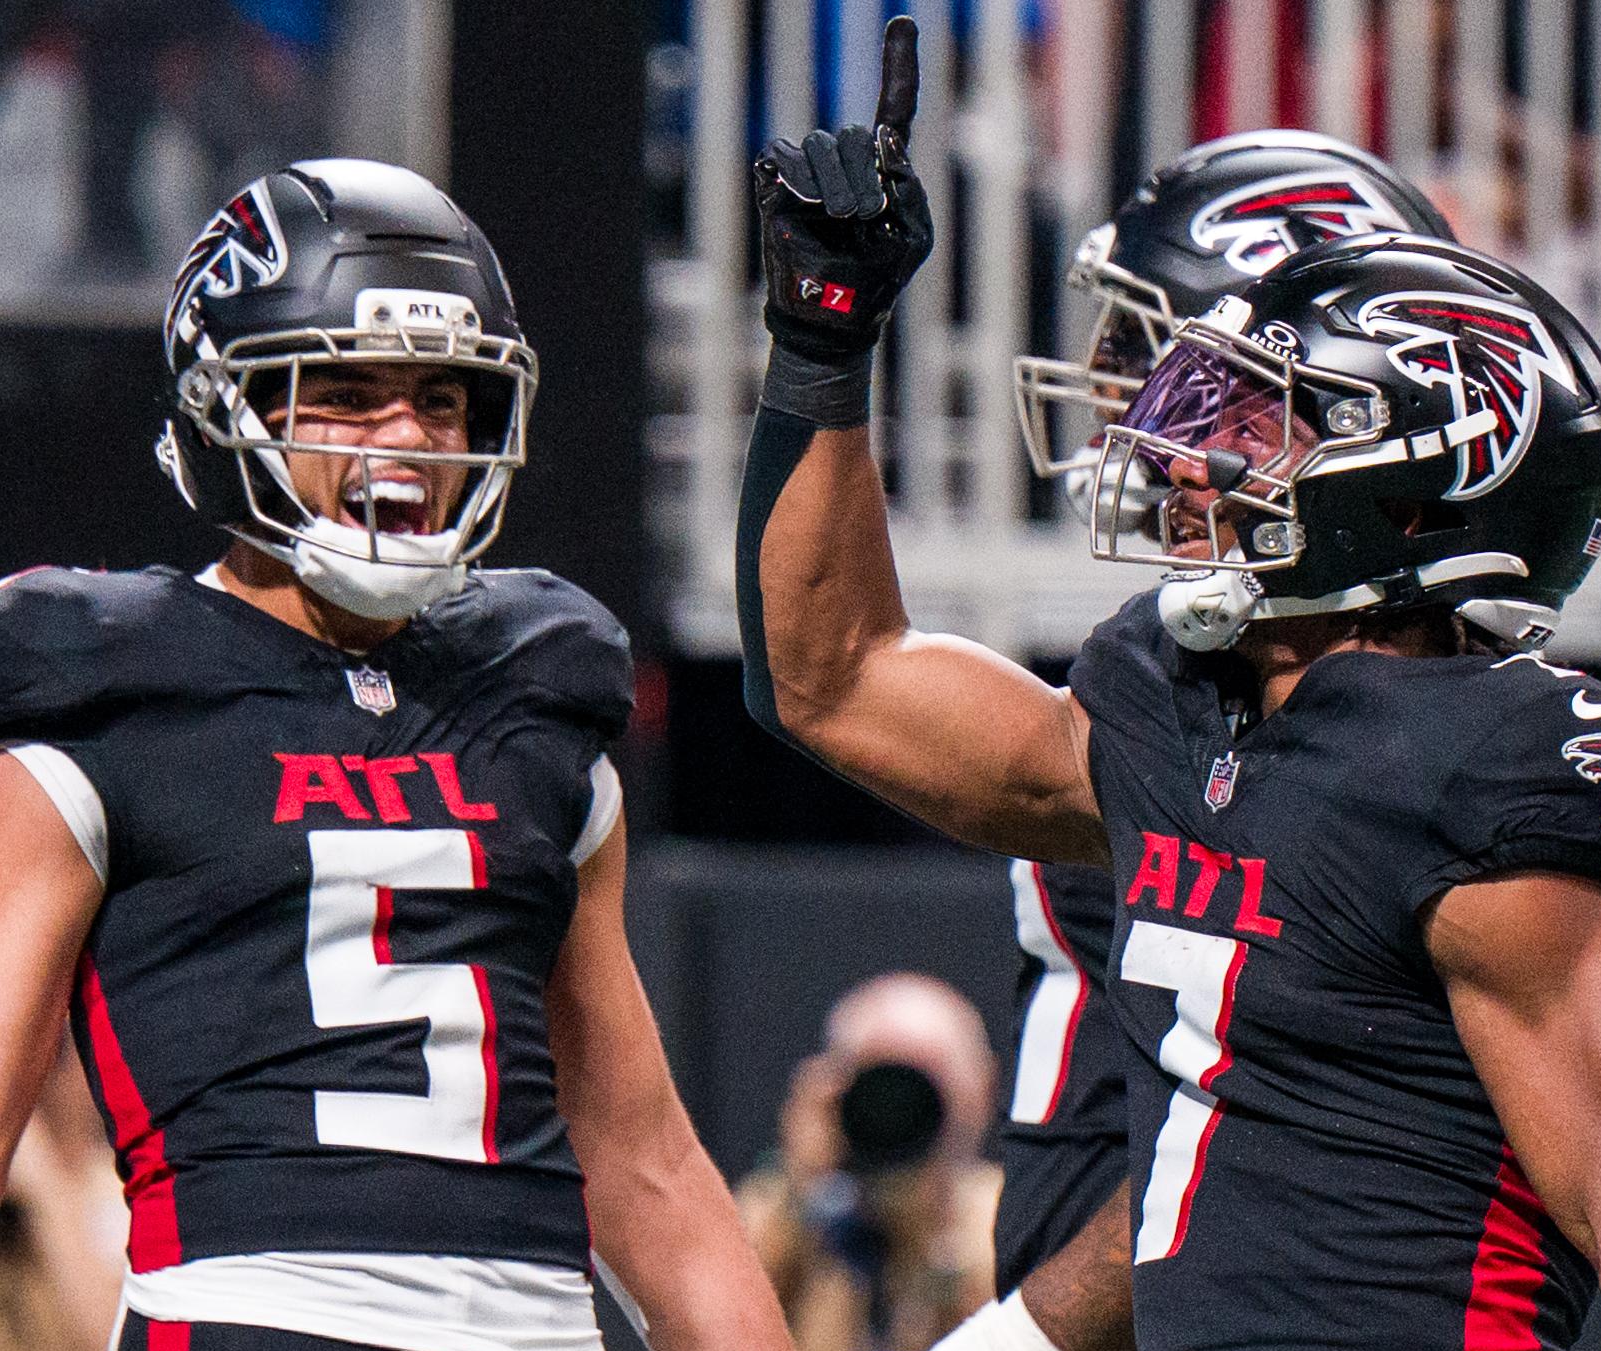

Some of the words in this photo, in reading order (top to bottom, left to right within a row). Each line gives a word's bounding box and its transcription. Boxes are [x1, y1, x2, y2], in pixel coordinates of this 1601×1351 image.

[407, 303, 445, 317] ATL
[830, 288, 845, 305] 7
[272, 751, 499, 824] ATL
[1125, 831, 1284, 939] ATL
[305, 829, 500, 1165] 5
[1120, 919, 1248, 1266] 7
